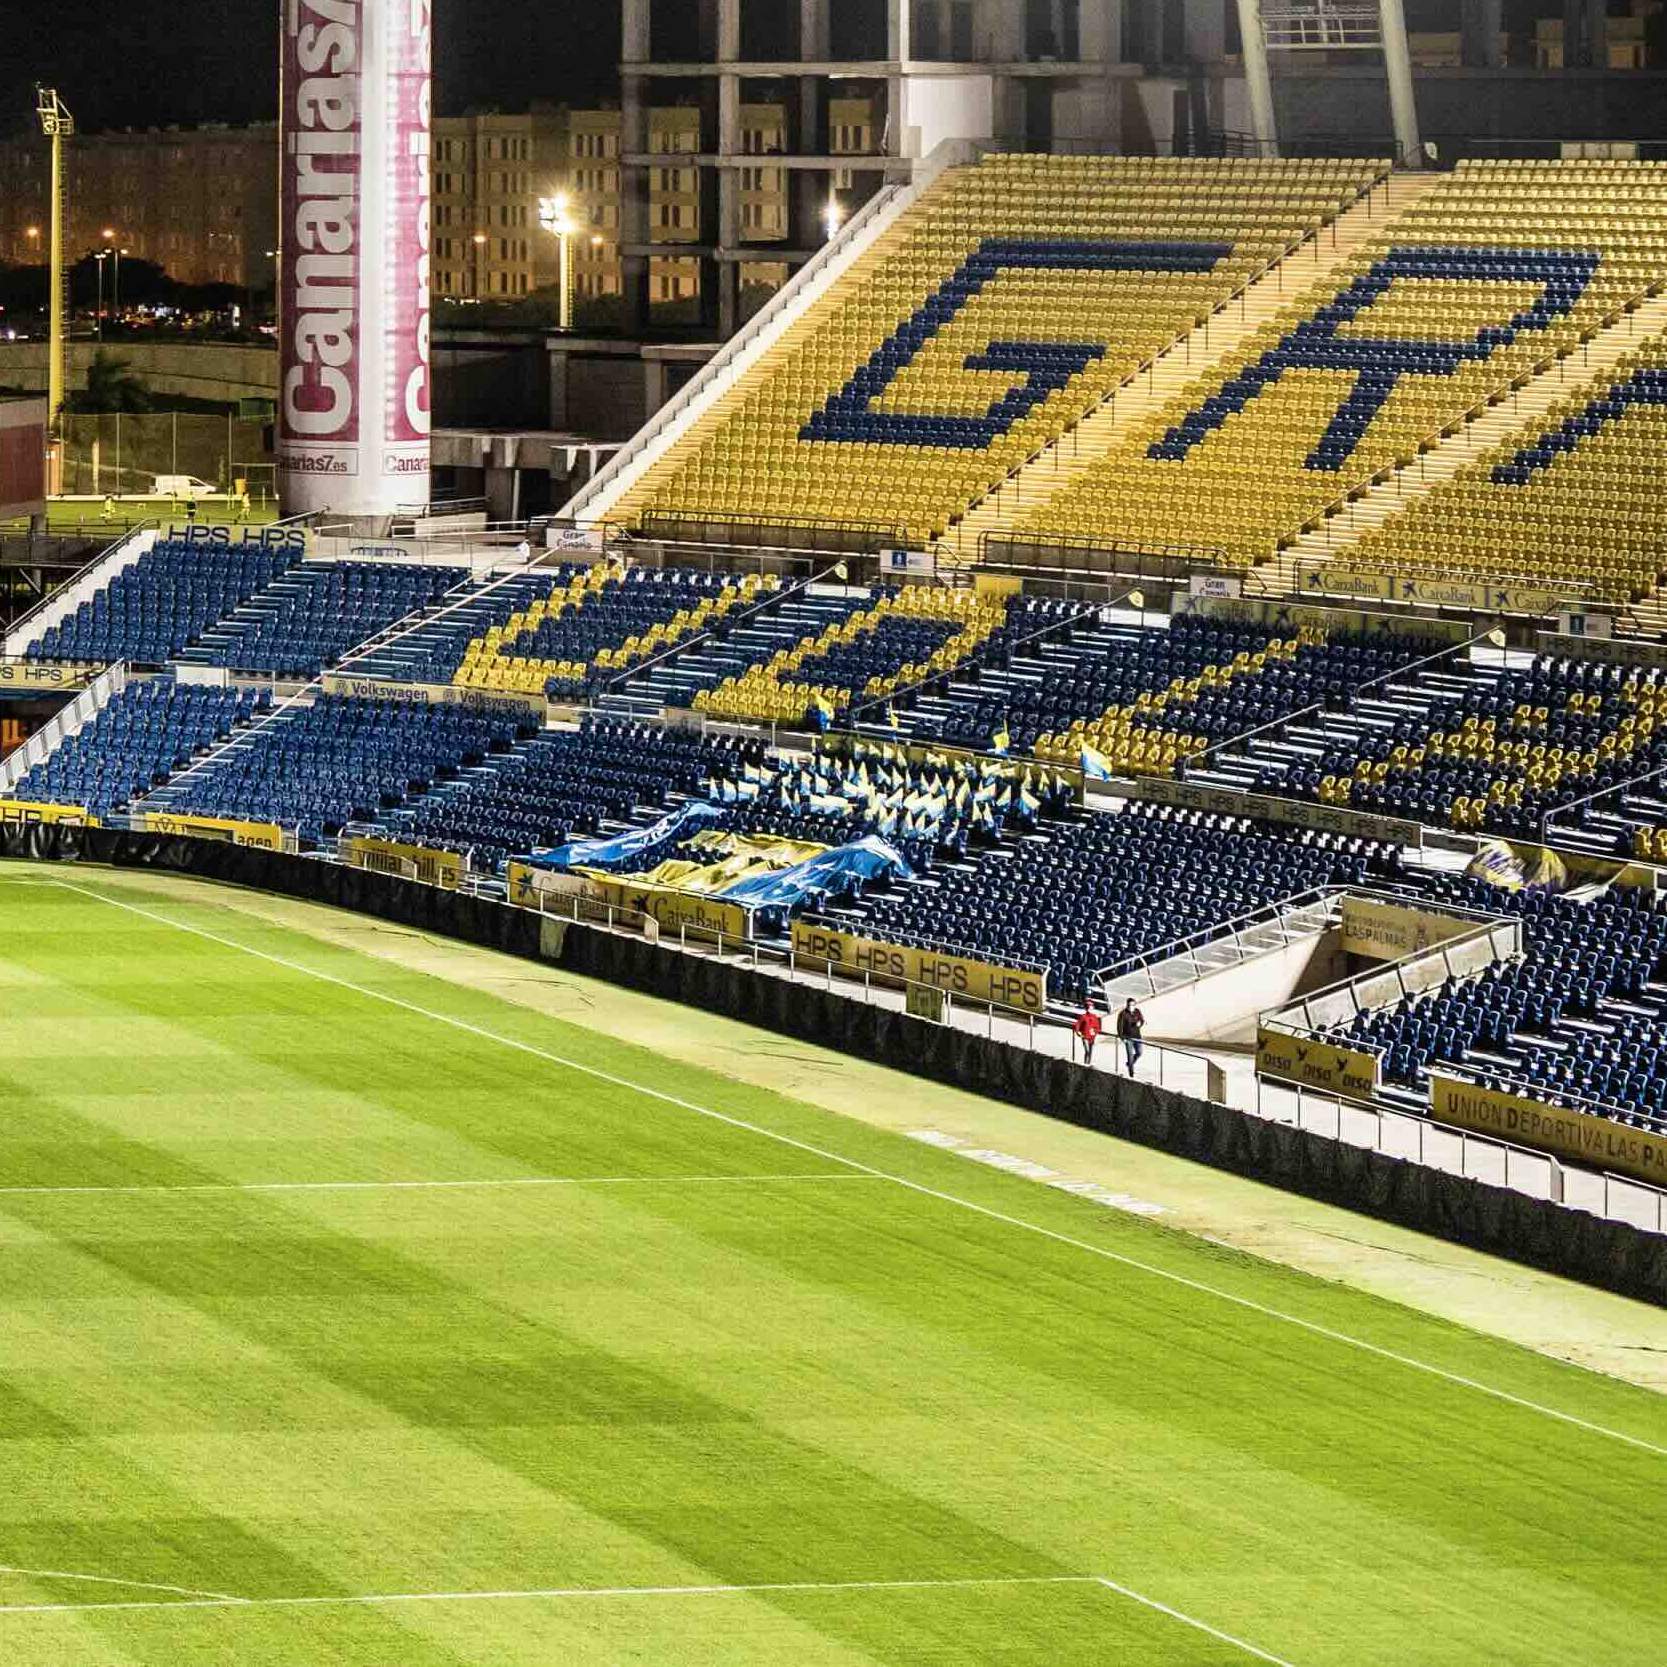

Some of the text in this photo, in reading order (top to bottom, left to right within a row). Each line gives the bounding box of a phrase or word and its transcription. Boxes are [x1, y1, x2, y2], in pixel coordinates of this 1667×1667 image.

[169, 525, 229, 543] HPS
[25, 668, 62, 682] HPS
[352, 683, 428, 701] Volkswagen
[459, 690, 531, 711] Volkswagen
[796, 931, 1039, 1008] HPS HPS HPS HPS
[1607, 1131, 1638, 1162] LAS
